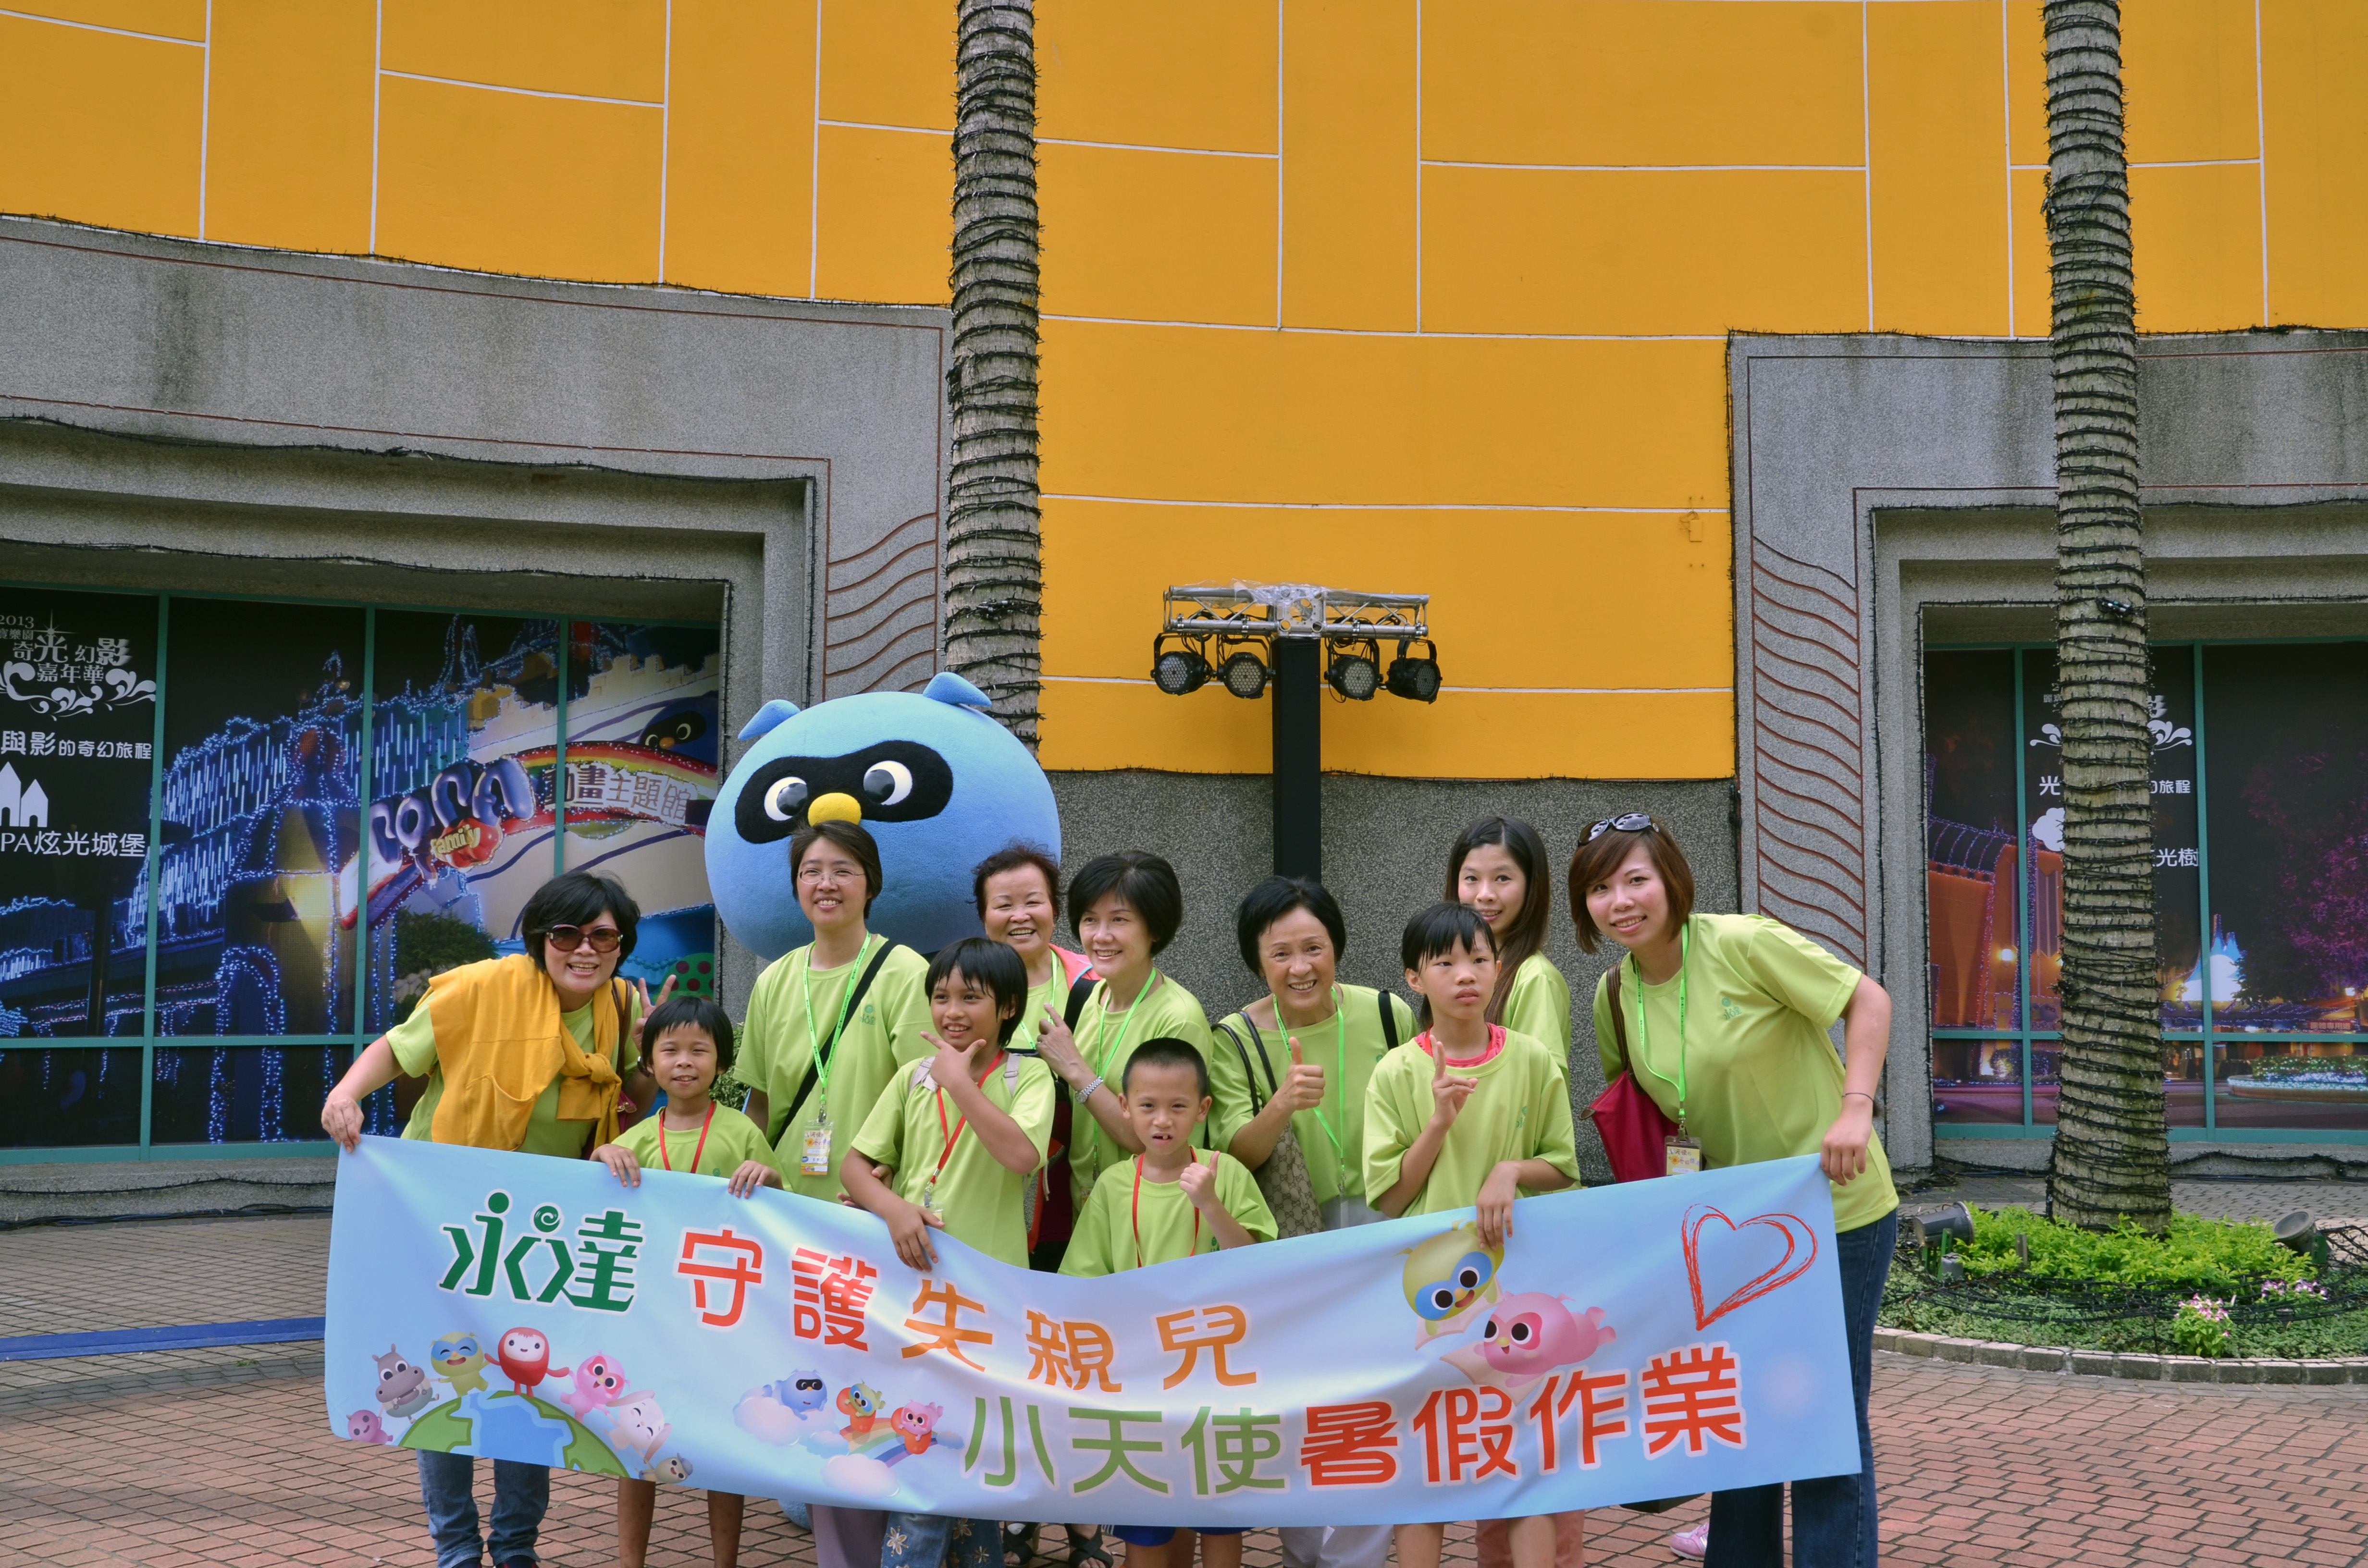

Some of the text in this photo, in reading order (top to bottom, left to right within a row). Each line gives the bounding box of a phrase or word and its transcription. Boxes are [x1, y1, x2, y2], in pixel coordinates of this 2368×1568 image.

[37, 662, 104, 684] 嘉年華
[1, 730, 152, 759] 與影的奇幻旅程
[2039, 775, 2060, 796] 光
[0, 831, 146, 857] PA炫光城堡
[2151, 848, 2199, 867] 光樹
[439, 1191, 643, 1313] 永達
[965, 1347, 1742, 1495] 小天使暑假作業
